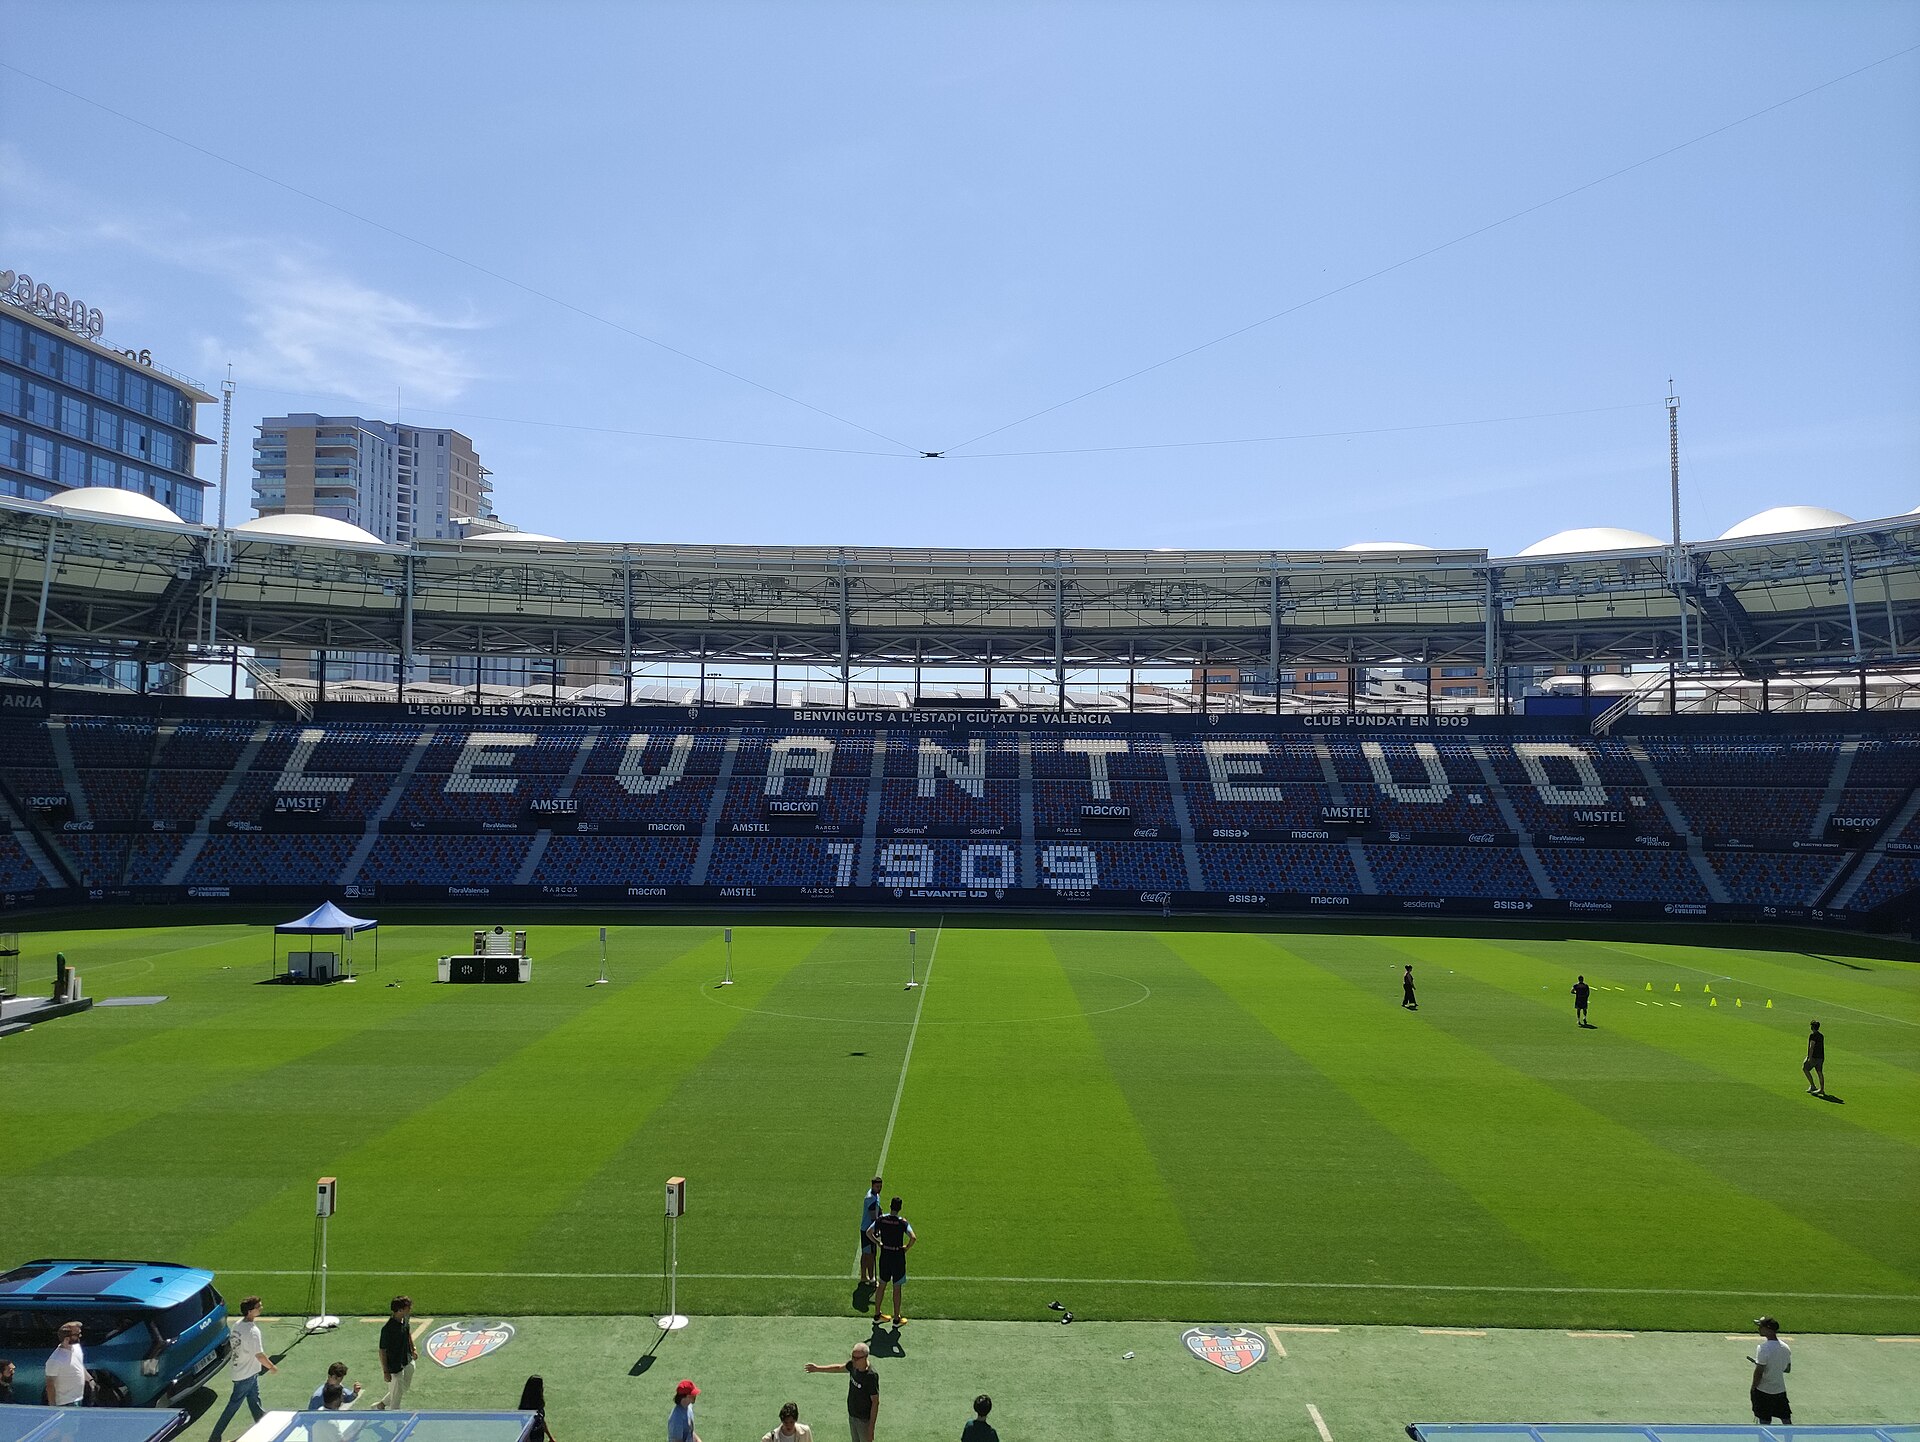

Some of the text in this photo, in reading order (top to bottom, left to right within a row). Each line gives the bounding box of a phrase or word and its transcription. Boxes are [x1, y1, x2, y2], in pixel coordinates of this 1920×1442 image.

[0, 694, 43, 708] ARIA
[408, 705, 607, 718] L'EQUIP DELS VALENCIANS
[793, 711, 1112, 725] BENVINGUTS A L'ESTADI CIUTAT DE VALÈNCIA
[1303, 716, 1470, 727] CLUB FUNDAT EN 1909
[769, 801, 818, 812] macron
[1080, 805, 1131, 816] macron
[1321, 807, 1371, 818] AMSTEL
[1573, 810, 1626, 822] AMSTEL
[648, 823, 686, 831] macron
[731, 823, 770, 832] AMSTEL
[1212, 829, 1242, 838] asisa
[1291, 831, 1329, 839] macron
[827, 843, 1098, 890] 1909
[448, 886, 490, 894] FibraValencia
[628, 887, 667, 896] macron
[719, 887, 756, 897] AMSTEL
[909, 890, 967, 898] LEVANTE
[1228, 894, 1258, 903] asisa
[1310, 896, 1350, 905] macron
[1403, 899, 1441, 909] sesderma
[1493, 900, 1525, 910] asisa
[1569, 900, 1612, 909] FibraValencia
